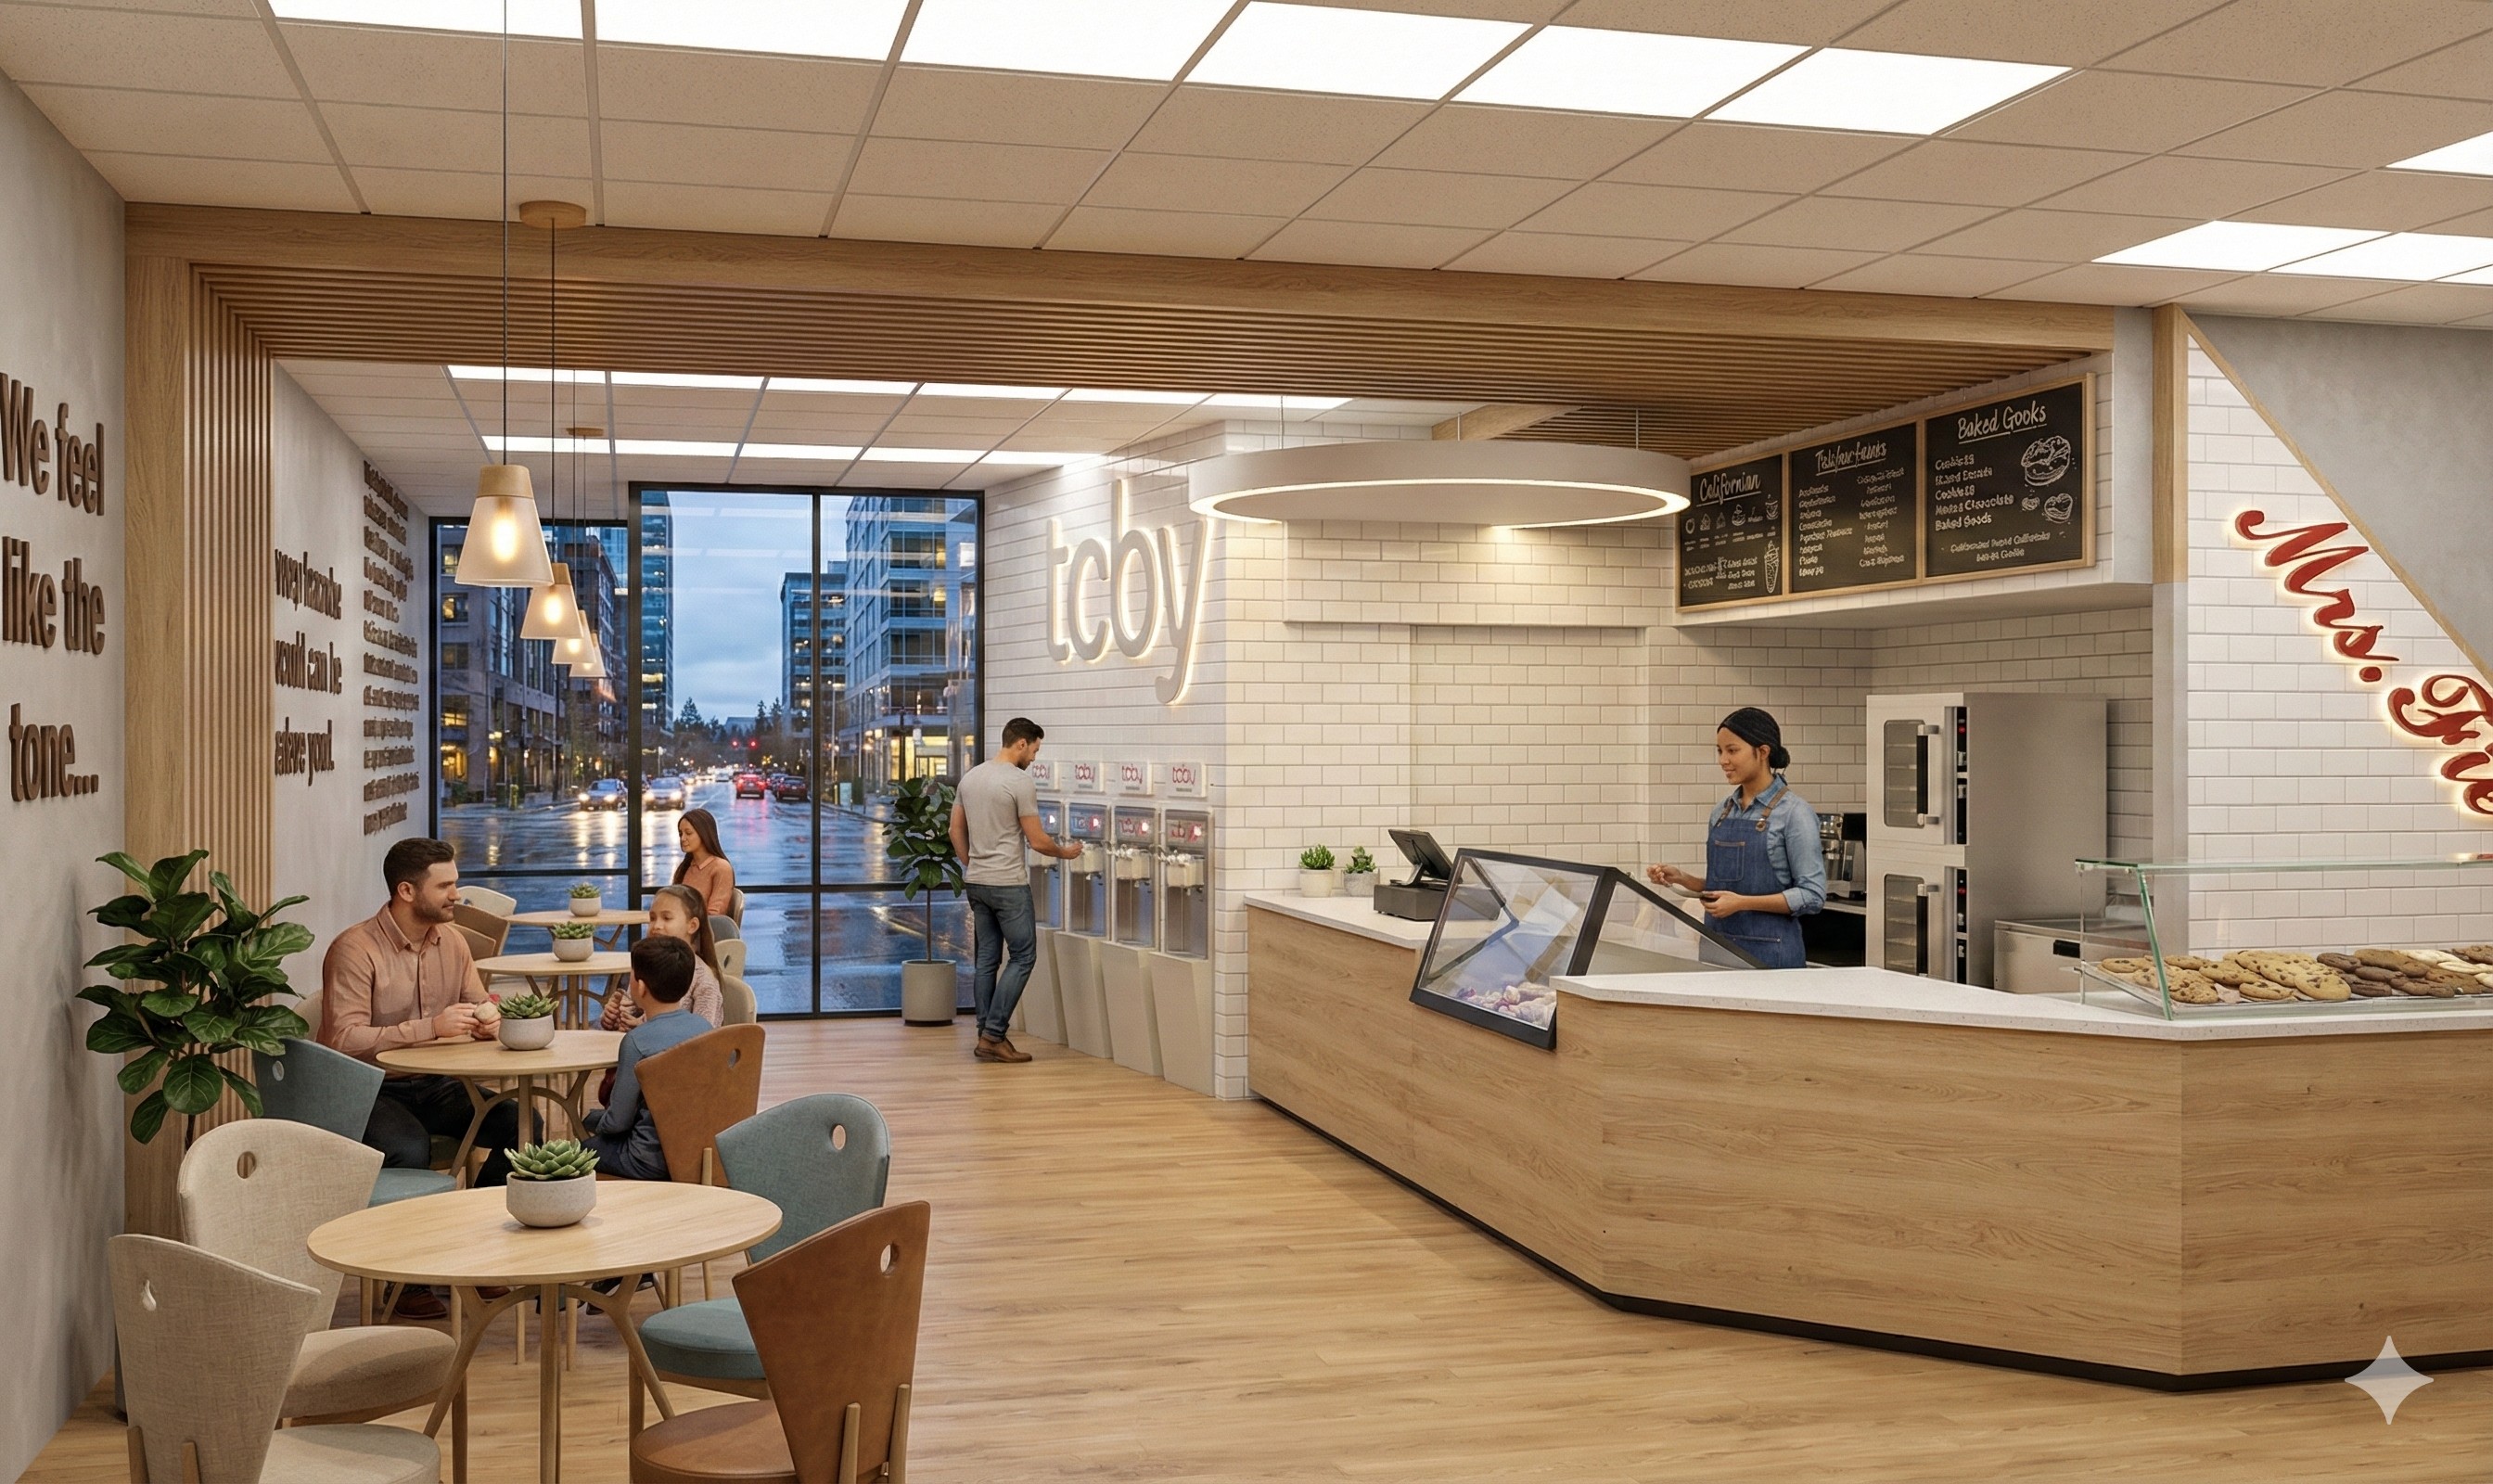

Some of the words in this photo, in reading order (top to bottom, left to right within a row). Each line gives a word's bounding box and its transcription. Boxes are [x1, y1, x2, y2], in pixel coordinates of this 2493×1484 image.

[0, 373, 49, 494] We
[55, 403, 104, 516] feel
[1958, 409, 2001, 440] Baked
[2, 536, 57, 648] like
[62, 557, 105, 655] the
[1046, 480, 1208, 705] tcby
[2234, 510, 2400, 682] Mrs.
